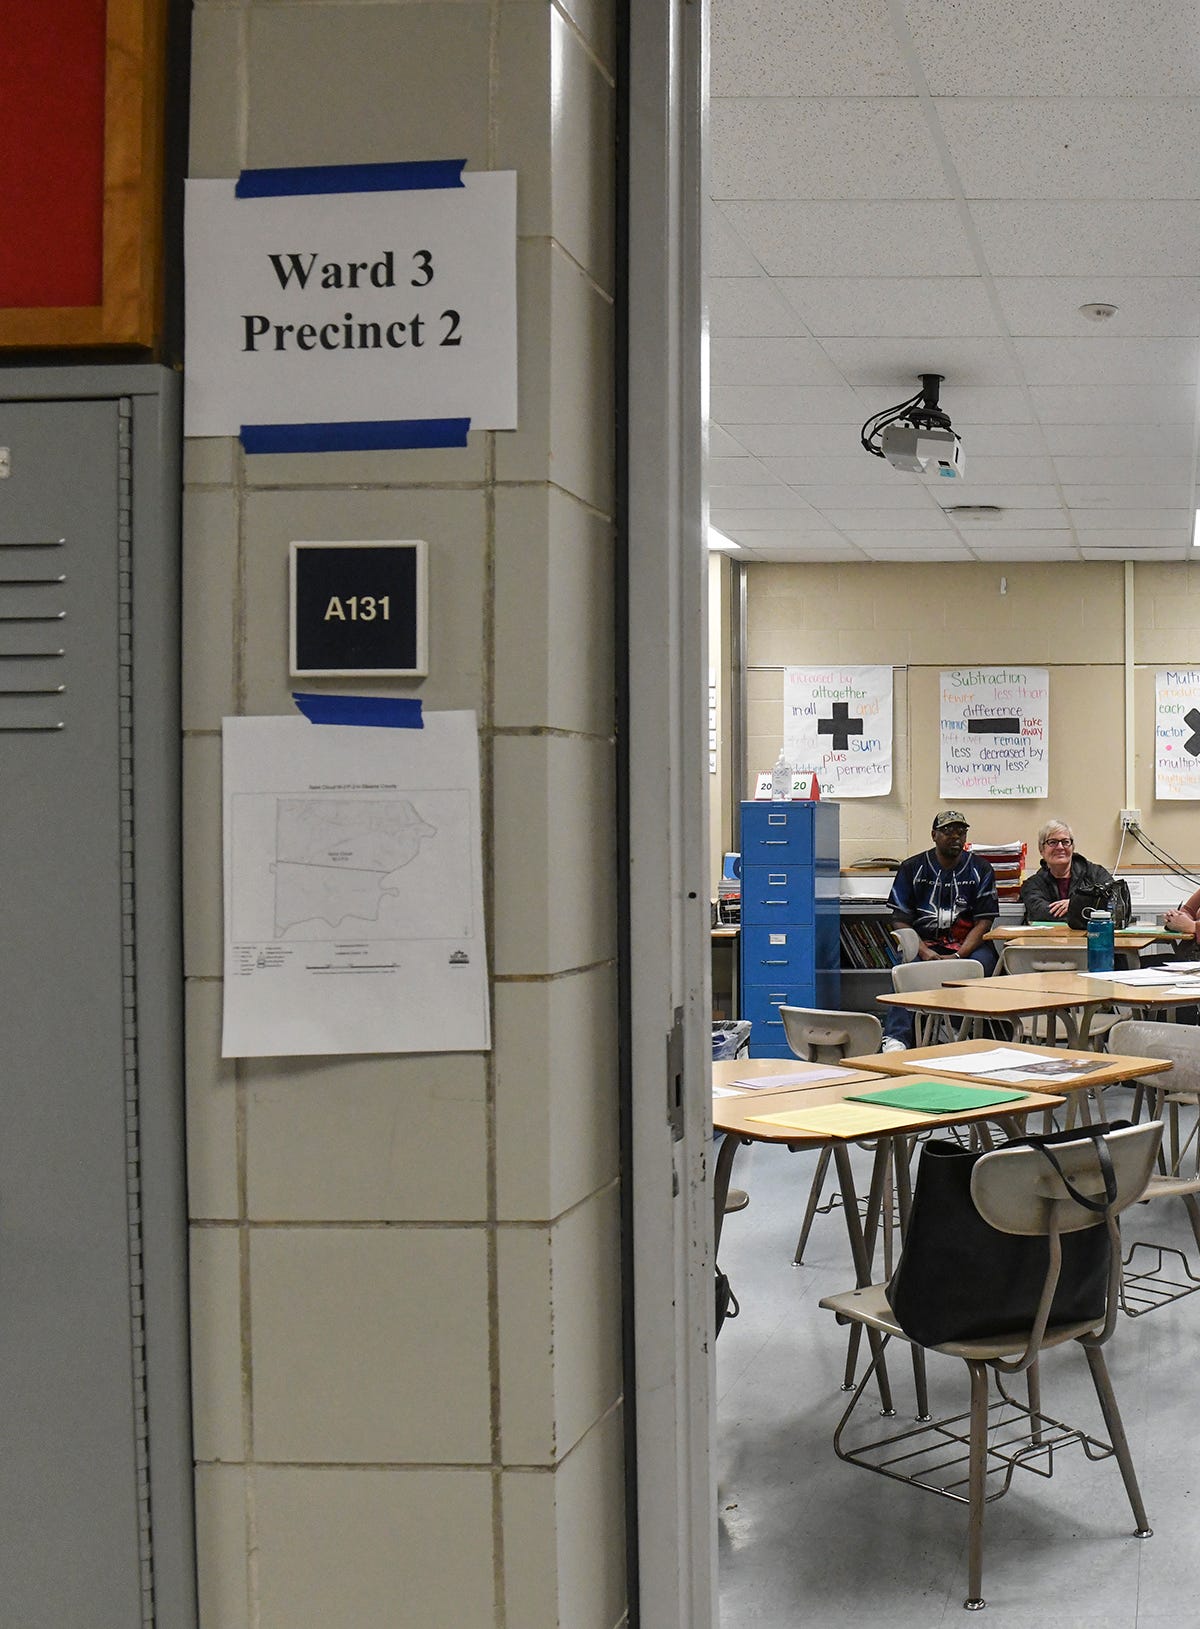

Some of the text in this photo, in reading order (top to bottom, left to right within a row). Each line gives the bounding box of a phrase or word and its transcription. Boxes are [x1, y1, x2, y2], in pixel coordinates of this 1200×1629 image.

[267, 249, 434, 290] Ward 3
[241, 309, 462, 352] Precinct 2
[324, 595, 390, 621] A131
[951, 670, 1027, 687] Subtraction
[812, 686, 867, 700] altogether
[963, 703, 1024, 718] difference
[1159, 703, 1185, 714] each
[1021, 717, 1043, 727] take
[1021, 728, 1043, 740] away
[1156, 725, 1187, 737] factor
[851, 739, 881, 752] sum
[994, 735, 1031, 746] remain
[822, 751, 847, 769] plus
[951, 746, 1043, 761] less decreased by
[836, 763, 890, 780] perimeter
[945, 761, 969, 773] how
[972, 763, 1000, 775] many
[793, 781, 807, 790] 20
[988, 784, 1042, 796] fewer than
